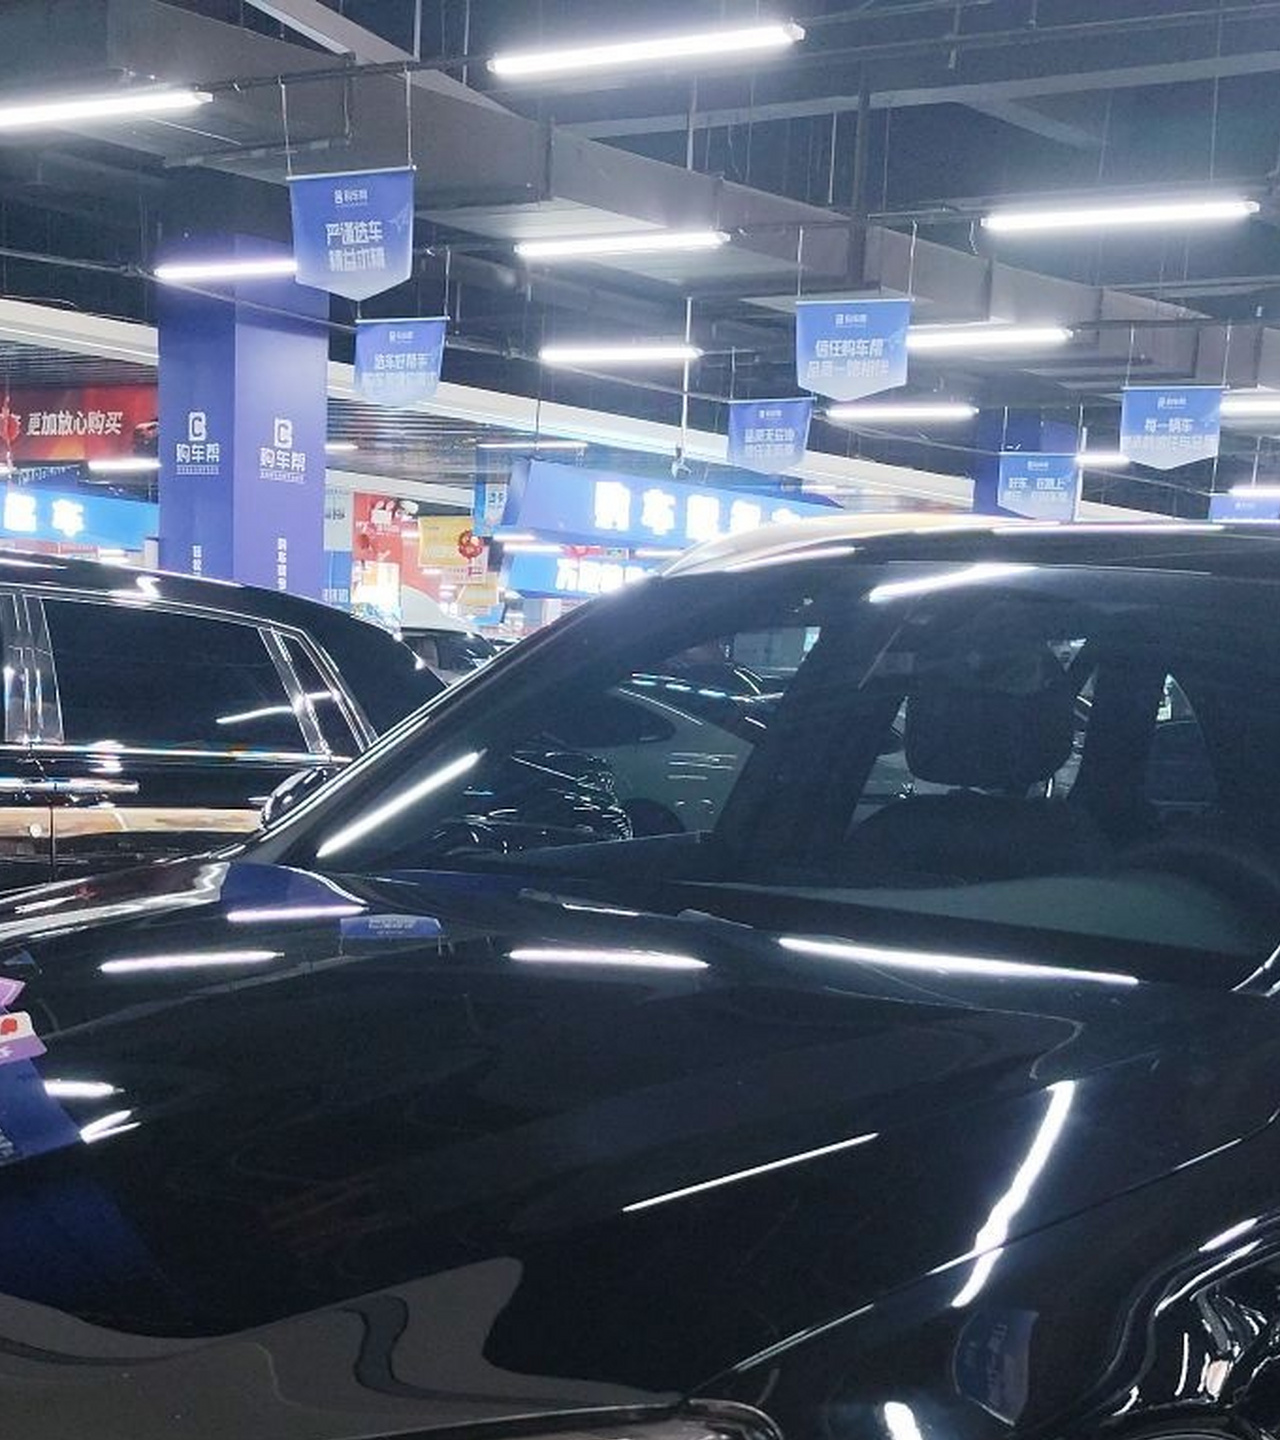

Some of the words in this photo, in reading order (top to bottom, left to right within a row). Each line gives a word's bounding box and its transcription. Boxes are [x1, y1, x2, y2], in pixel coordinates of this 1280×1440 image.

[26, 410, 123, 436] 更加放心购买
[176, 443, 220, 463] 购车帮
[260, 447, 306, 472] 购车帮
